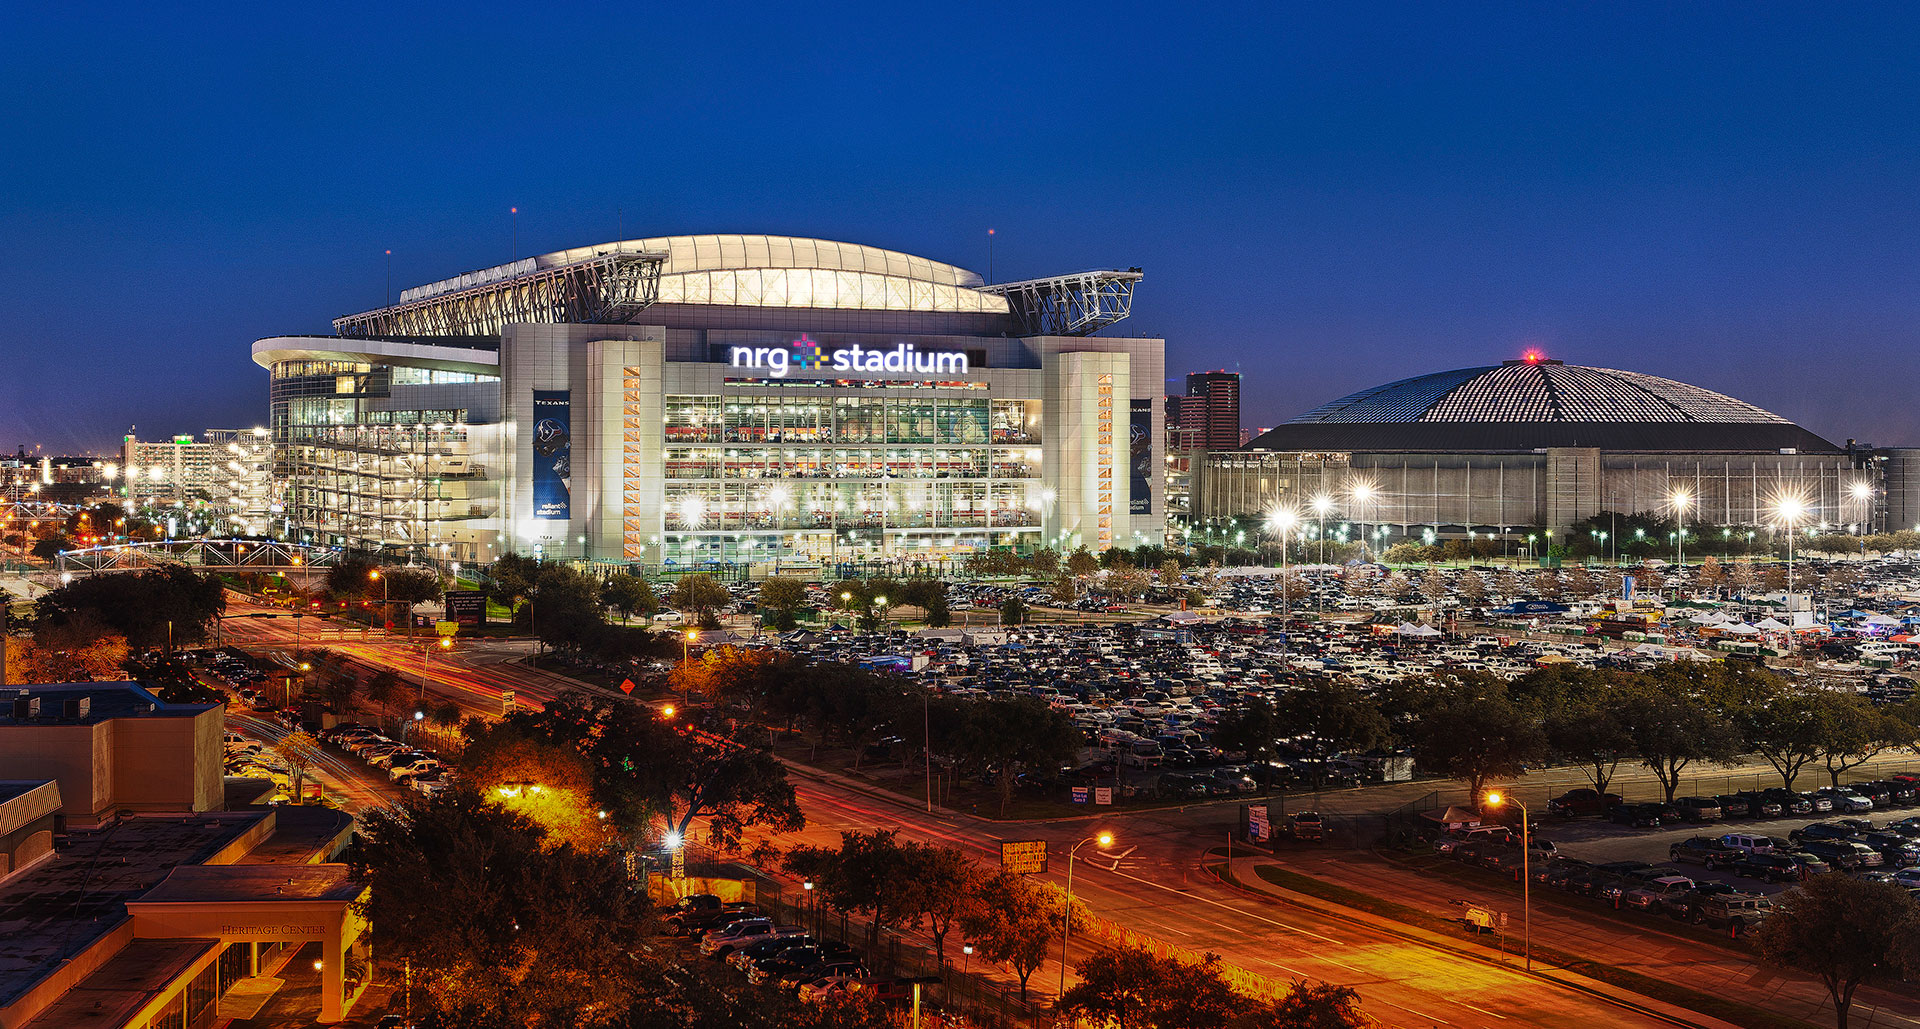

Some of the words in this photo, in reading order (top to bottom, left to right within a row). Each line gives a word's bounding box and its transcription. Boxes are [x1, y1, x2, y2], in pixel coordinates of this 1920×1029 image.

[732, 346, 789, 377] nrg
[832, 343, 969, 373] stadium
[221, 924, 279, 935] HERITAGE
[281, 924, 327, 935] CENTER
